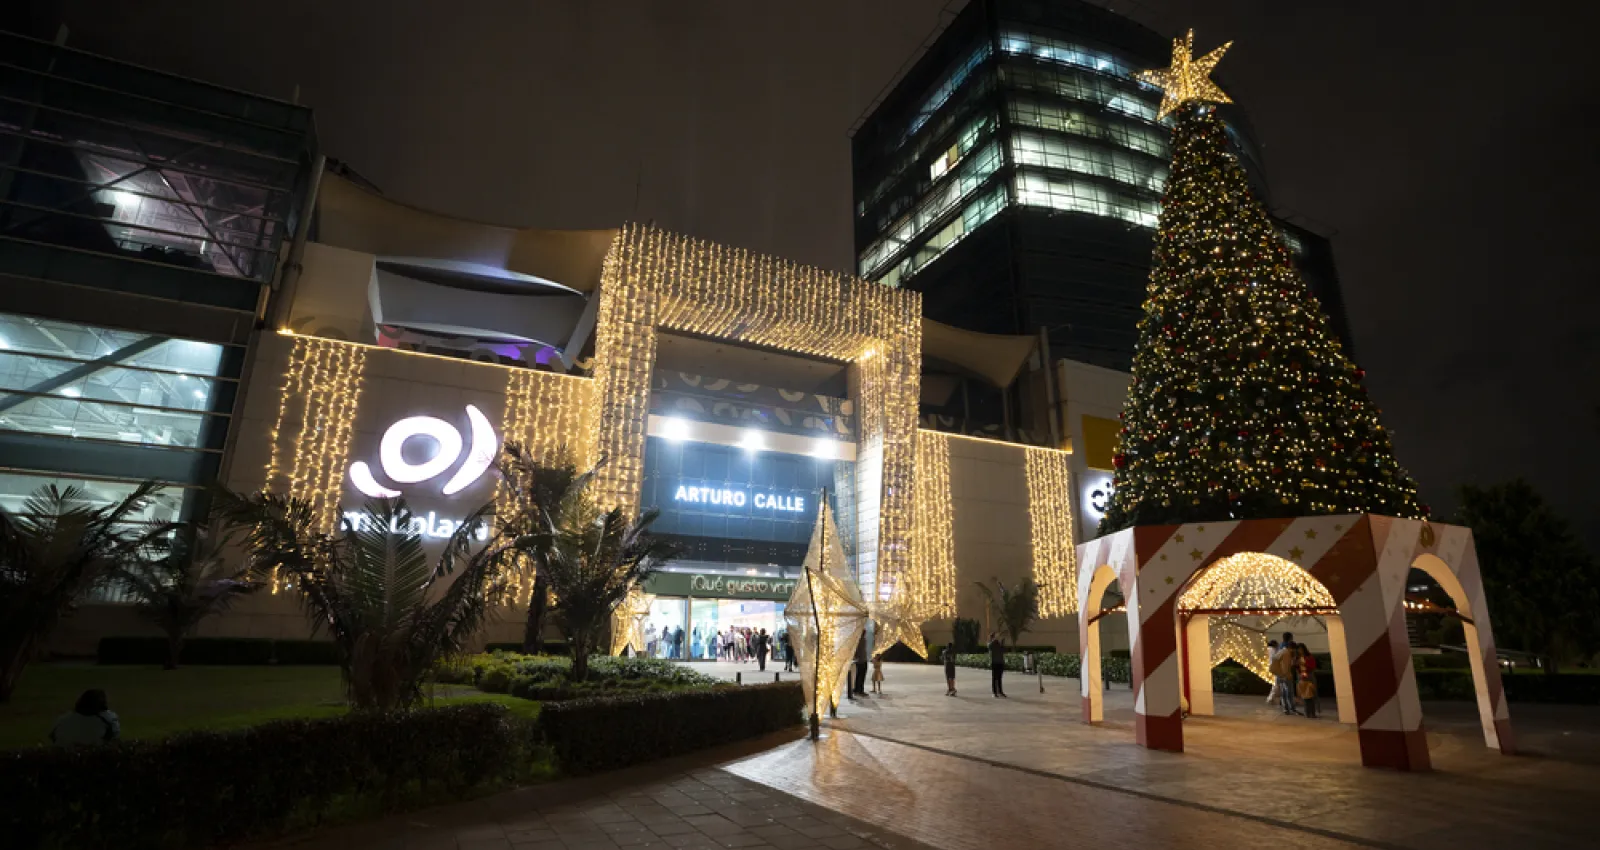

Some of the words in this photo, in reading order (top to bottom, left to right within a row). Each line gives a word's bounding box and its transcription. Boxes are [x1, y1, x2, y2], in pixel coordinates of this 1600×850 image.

[675, 486, 746, 507] ARTURO
[754, 493, 804, 512] CALLE
[726, 579, 768, 595] gusto
